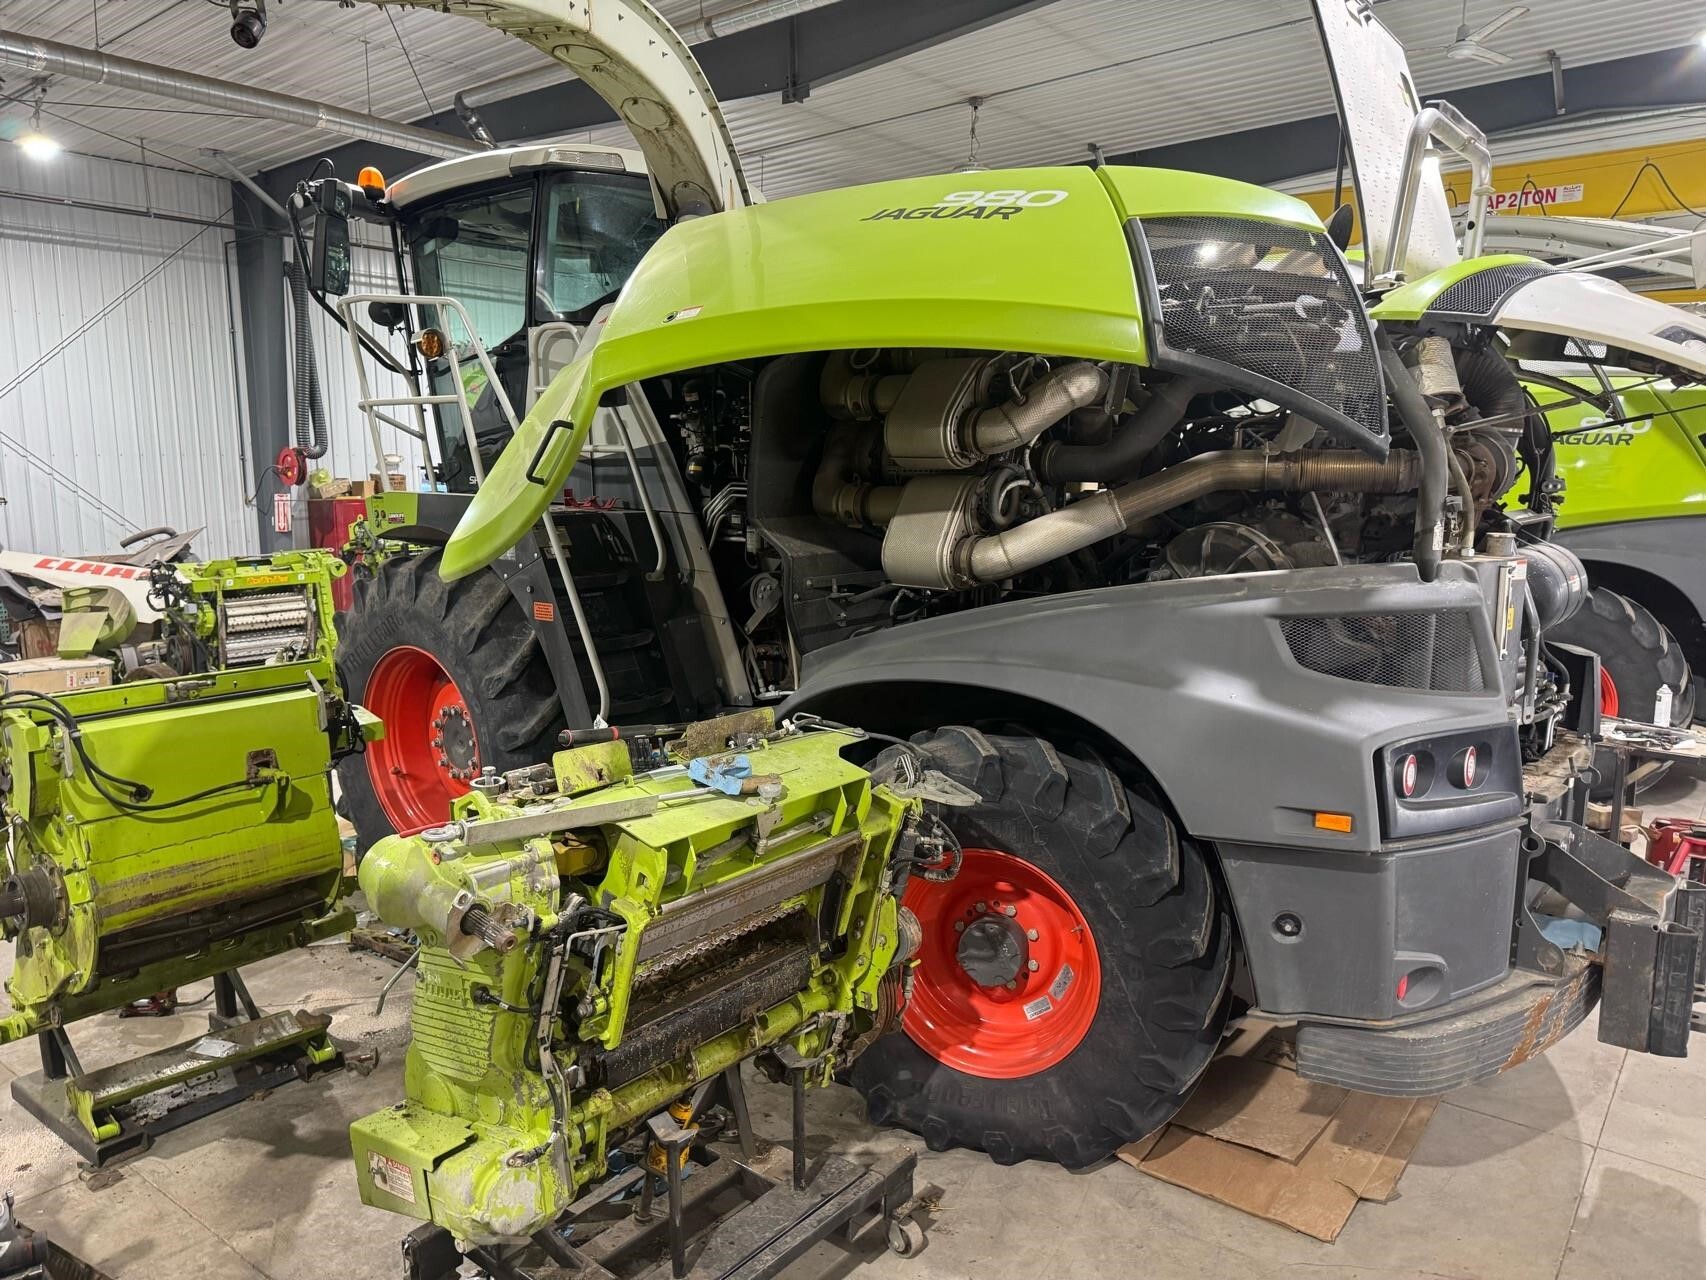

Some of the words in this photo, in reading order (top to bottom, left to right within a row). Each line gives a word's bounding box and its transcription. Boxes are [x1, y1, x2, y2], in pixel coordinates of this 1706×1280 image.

[934, 188, 1069, 208] 980
[1487, 194, 1506, 210] AP
[1508, 192, 1518, 208] 2
[1522, 187, 1557, 206] TON
[859, 205, 1024, 222] JAGUAR
[1552, 432, 1635, 447] AGUAR
